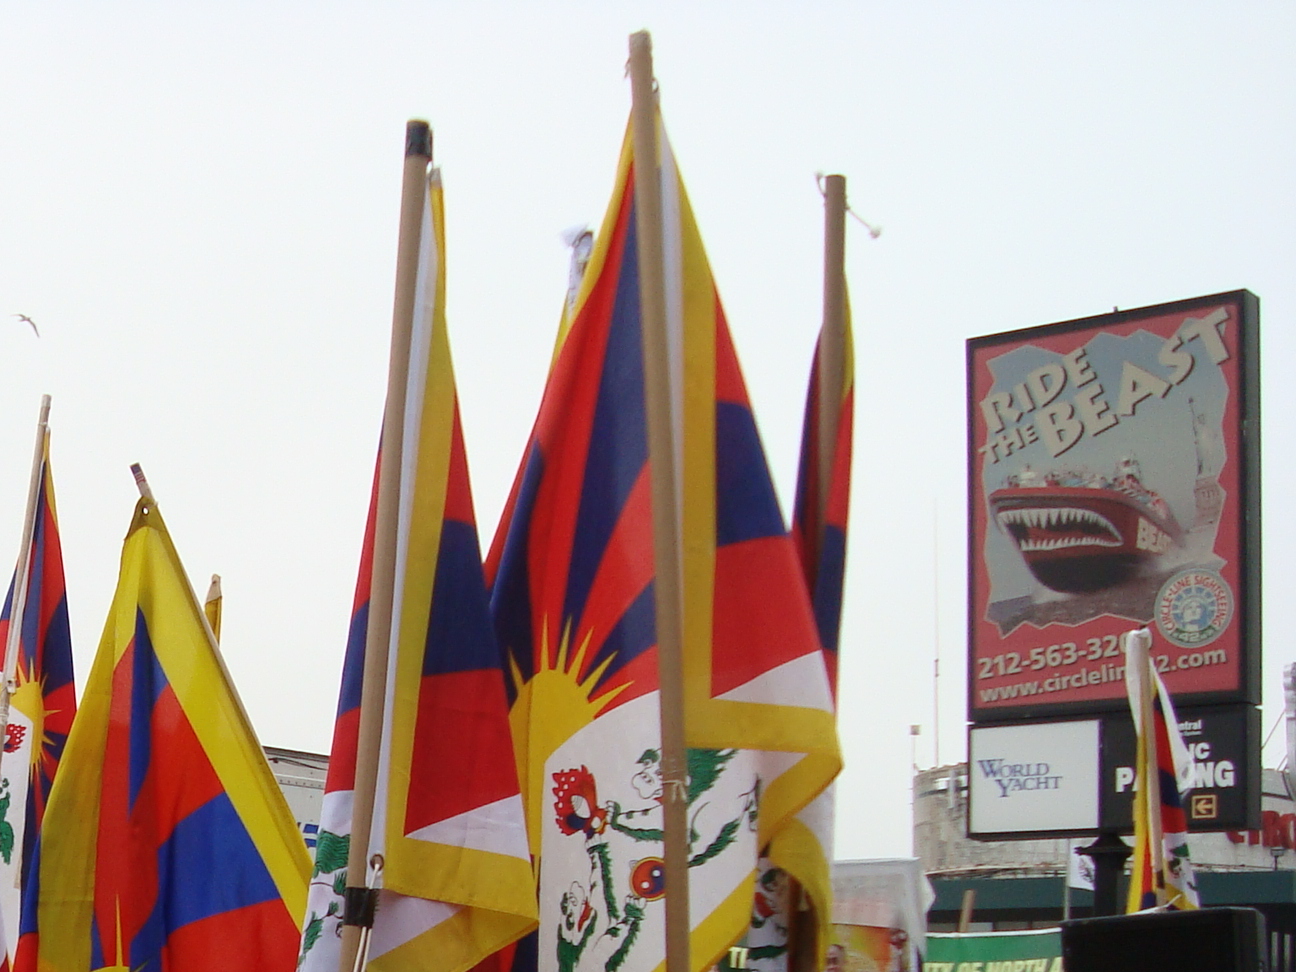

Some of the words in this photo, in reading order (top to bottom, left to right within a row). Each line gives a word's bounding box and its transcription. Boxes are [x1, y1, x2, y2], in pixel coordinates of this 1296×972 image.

[978, 424, 1039, 465] THE
[1034, 307, 1231, 458] BEAST
[979, 348, 1099, 434] RIDE
[995, 775, 1063, 798] YACHT
